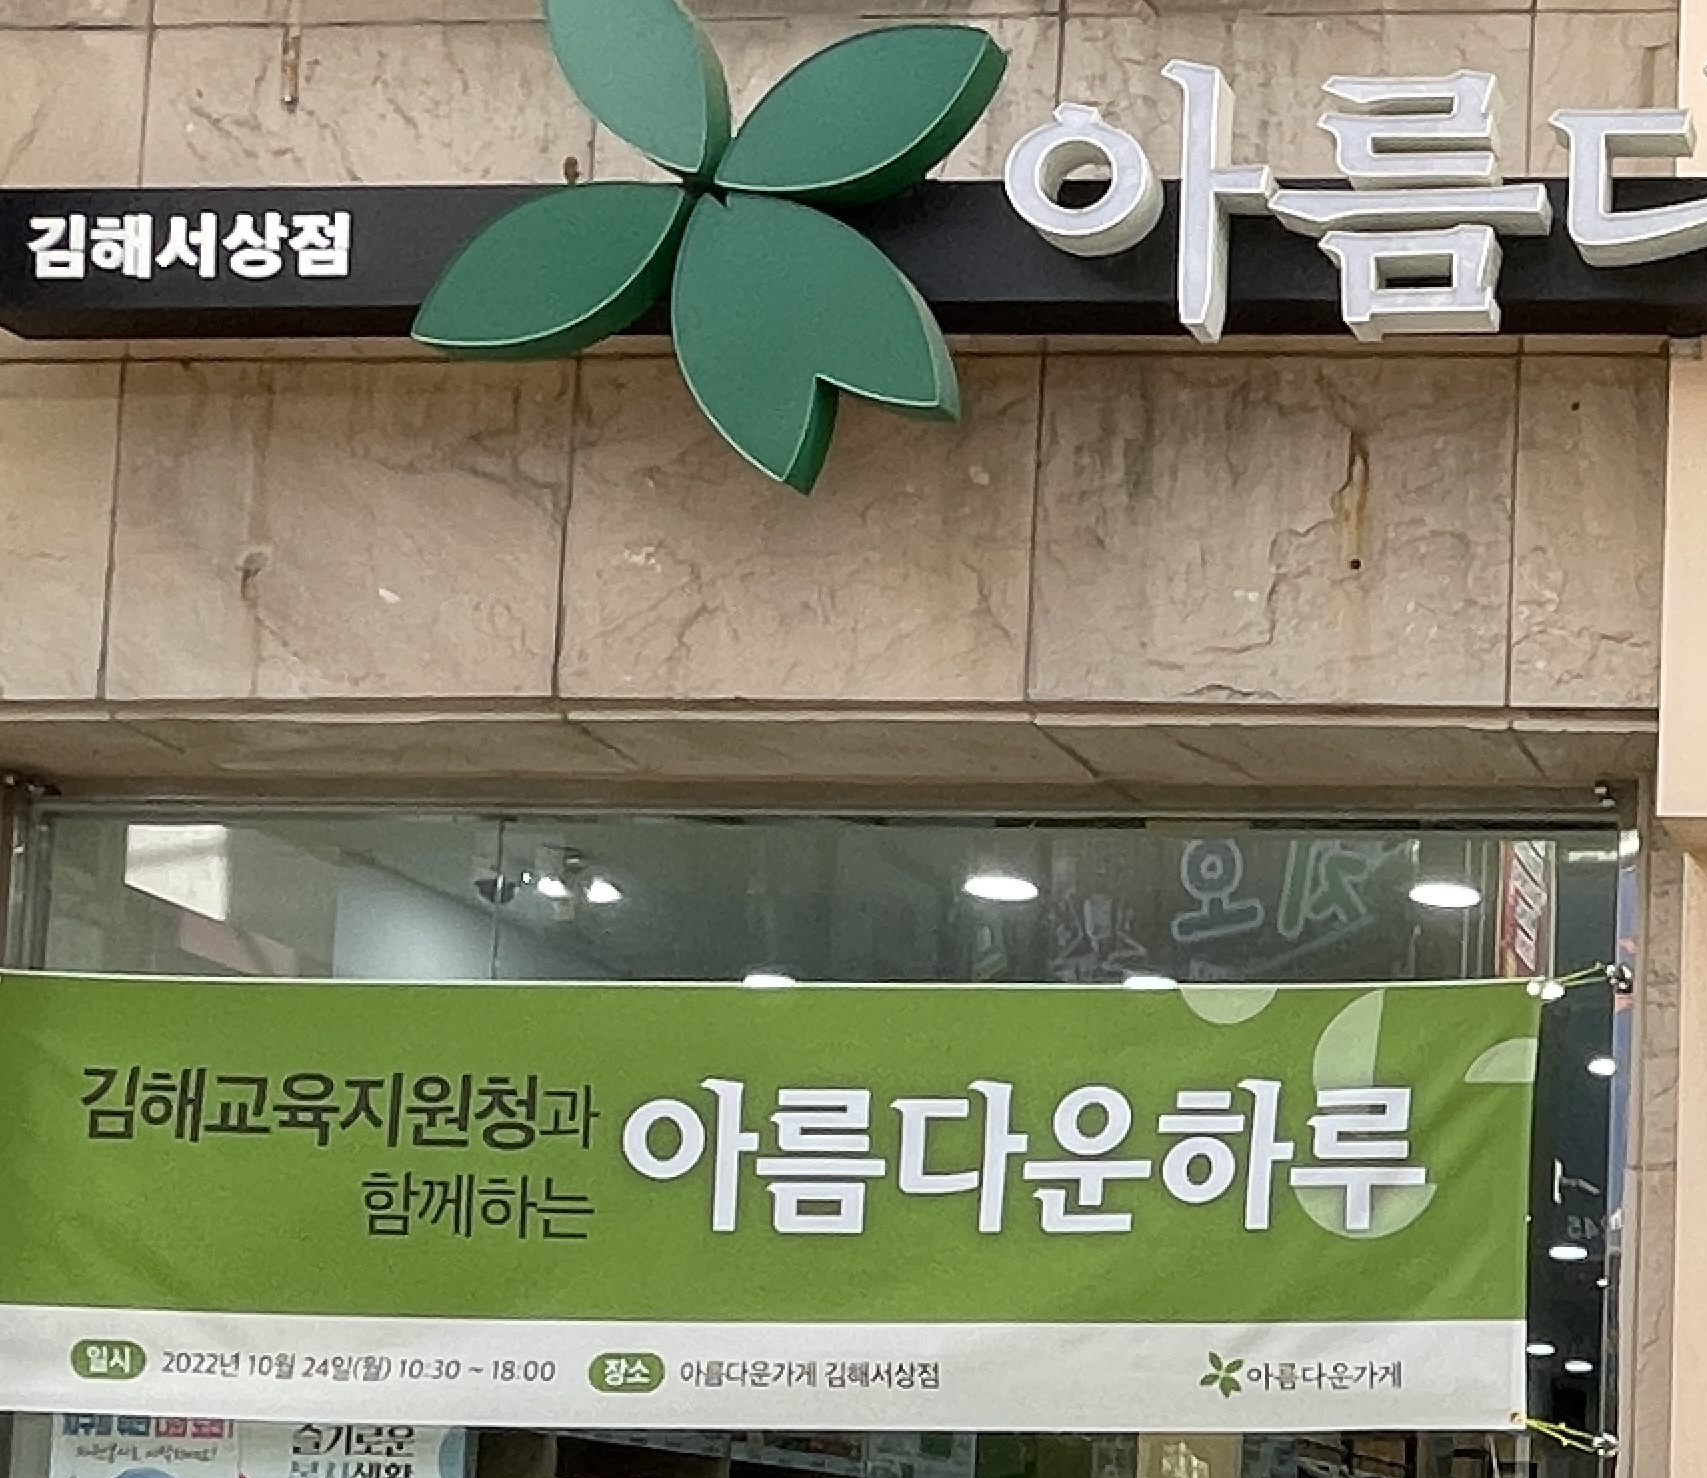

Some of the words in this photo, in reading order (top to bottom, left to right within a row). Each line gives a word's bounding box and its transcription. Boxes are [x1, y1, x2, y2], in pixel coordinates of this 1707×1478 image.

[27, 211, 351, 279] 김해서상점
[80, 1066, 599, 1151] 김해교육지원청과
[622, 1077, 1428, 1236] 아름다운하루
[361, 1169, 595, 1240] 함께하는
[86, 1345, 132, 1374] 일시
[161, 1350, 241, 1378] 2022년
[248, 1352, 296, 1380] 10월
[302, 1355, 393, 1382] 24일(월)
[400, 1357, 461, 1380] 10:30
[492, 1359, 556, 1382] 18:00
[604, 1358, 653, 1386] 장소
[679, 1359, 818, 1388] 아름다운가게
[825, 1360, 941, 1390] 김해서상점
[1246, 1360, 1402, 1392] 아름다운가게
[292, 1422, 416, 1458] 슬기로운
